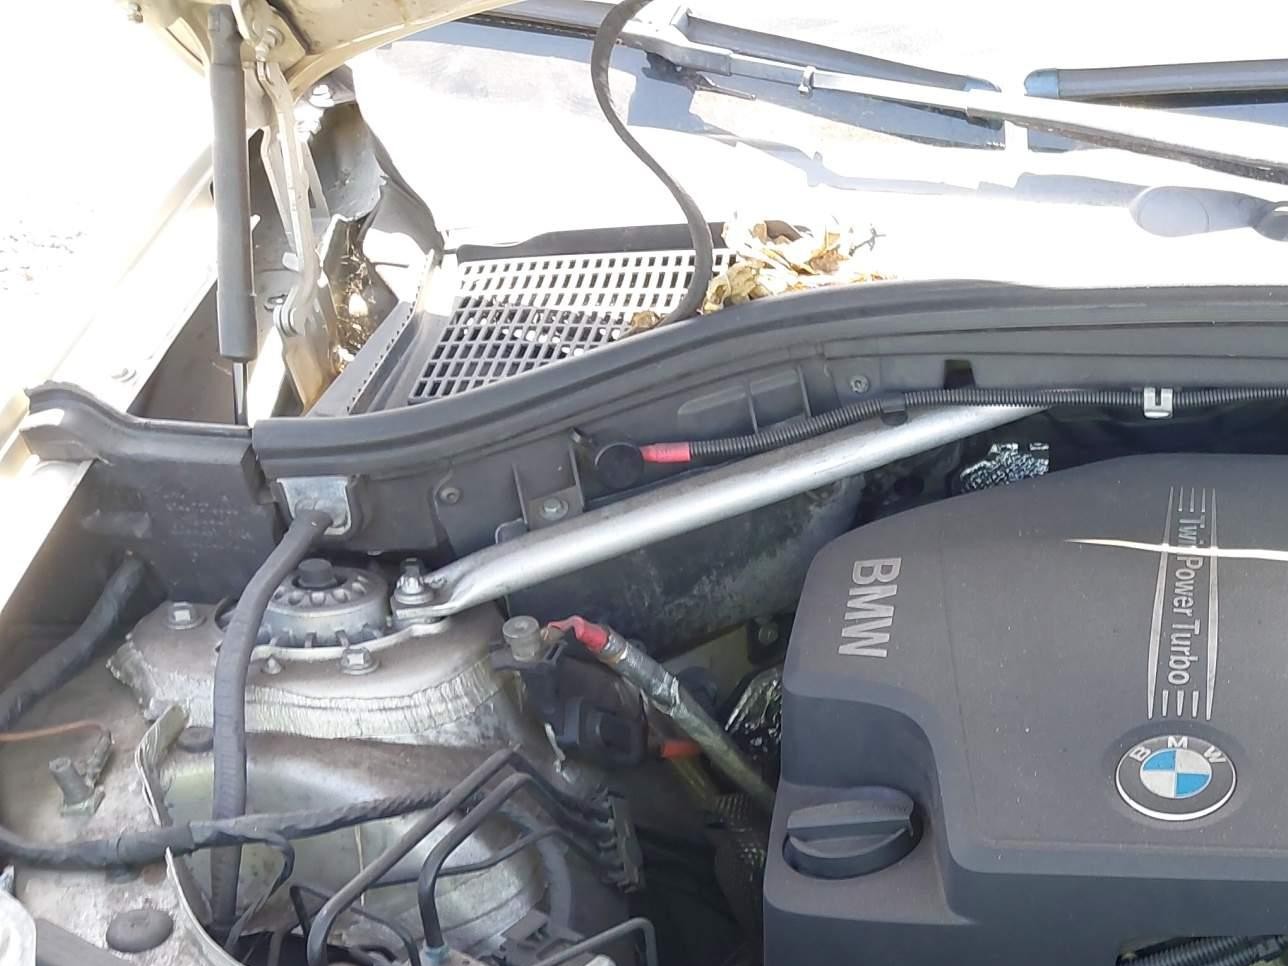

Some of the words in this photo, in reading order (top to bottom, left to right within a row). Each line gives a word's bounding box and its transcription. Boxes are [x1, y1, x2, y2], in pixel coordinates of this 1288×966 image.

[837, 556, 903, 659] BMW
[1167, 618, 1201, 686] Turbo
[1128, 734, 1227, 765] BMW
